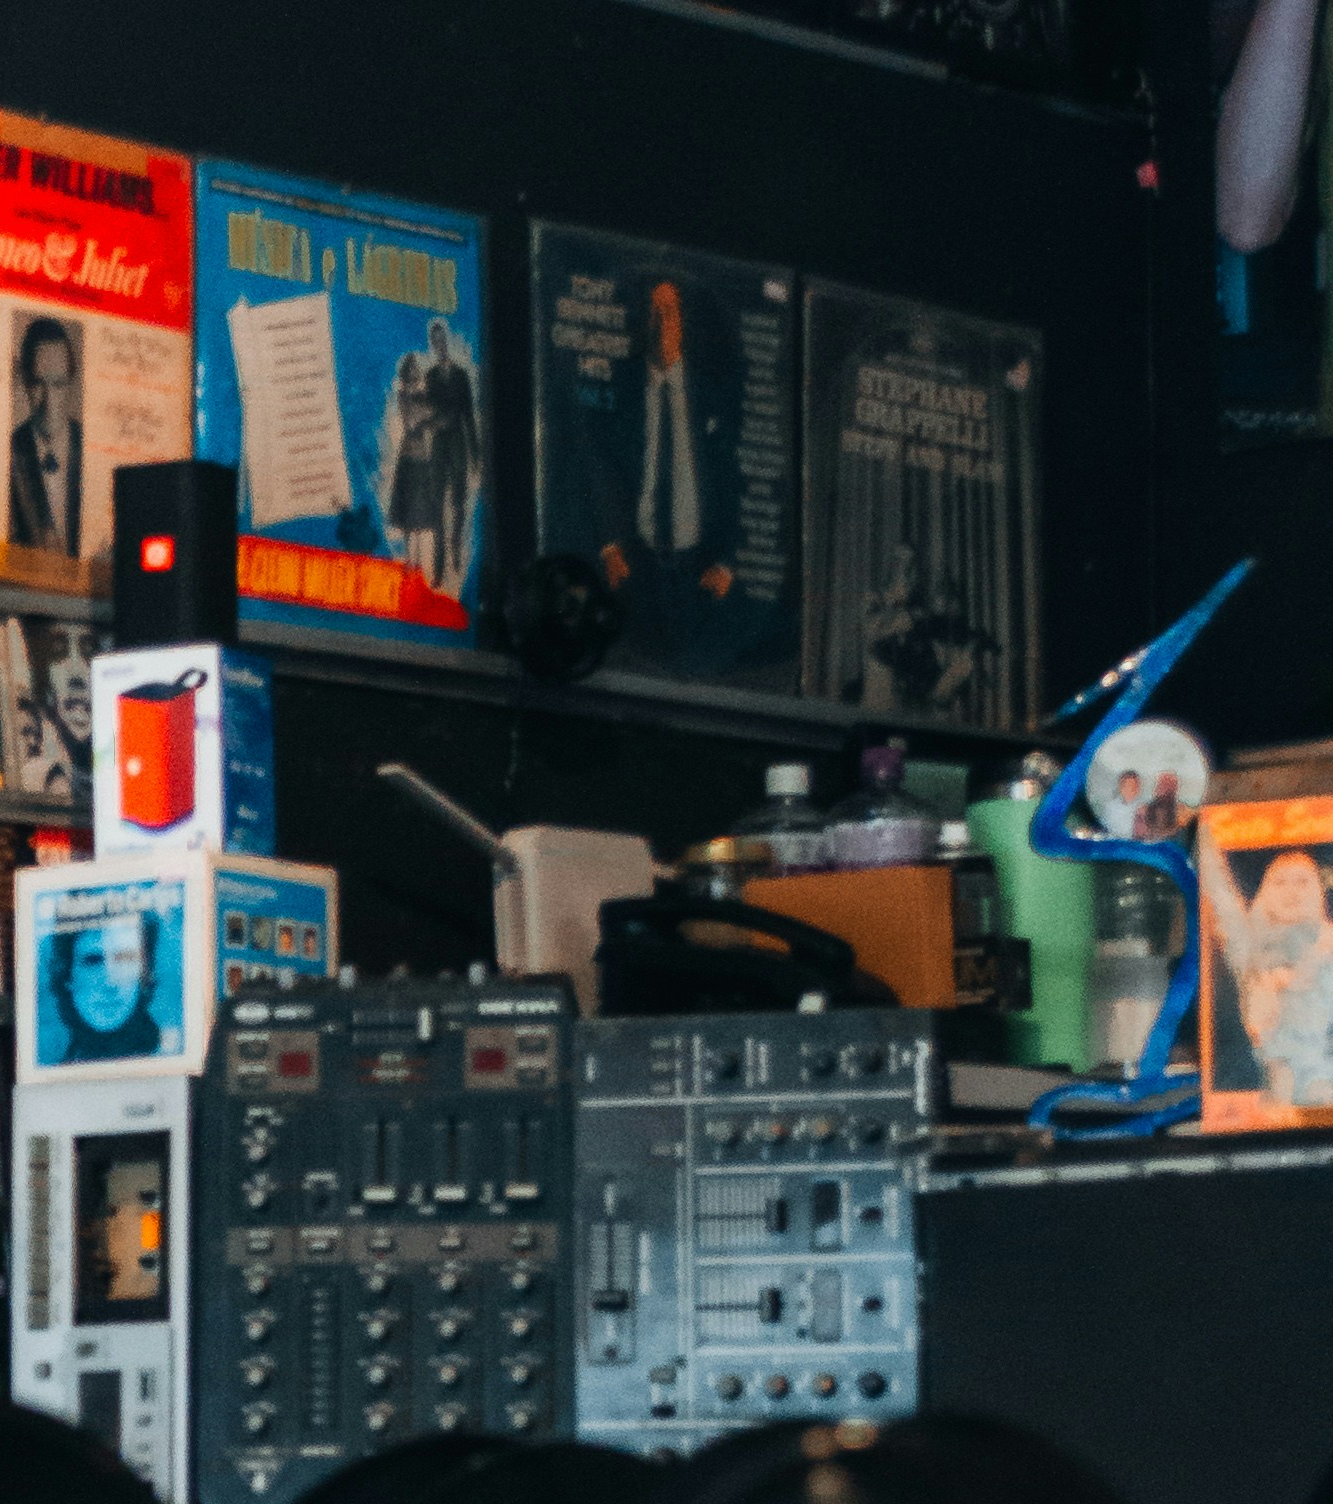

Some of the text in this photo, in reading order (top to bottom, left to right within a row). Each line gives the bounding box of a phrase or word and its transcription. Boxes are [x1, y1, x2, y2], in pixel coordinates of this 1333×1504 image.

[32, 149, 158, 215] WILLIAMS
[72, 237, 151, 300] Juliet
[858, 365, 989, 420] STEPHANE
[855, 397, 990, 451] GRAPPELLI
